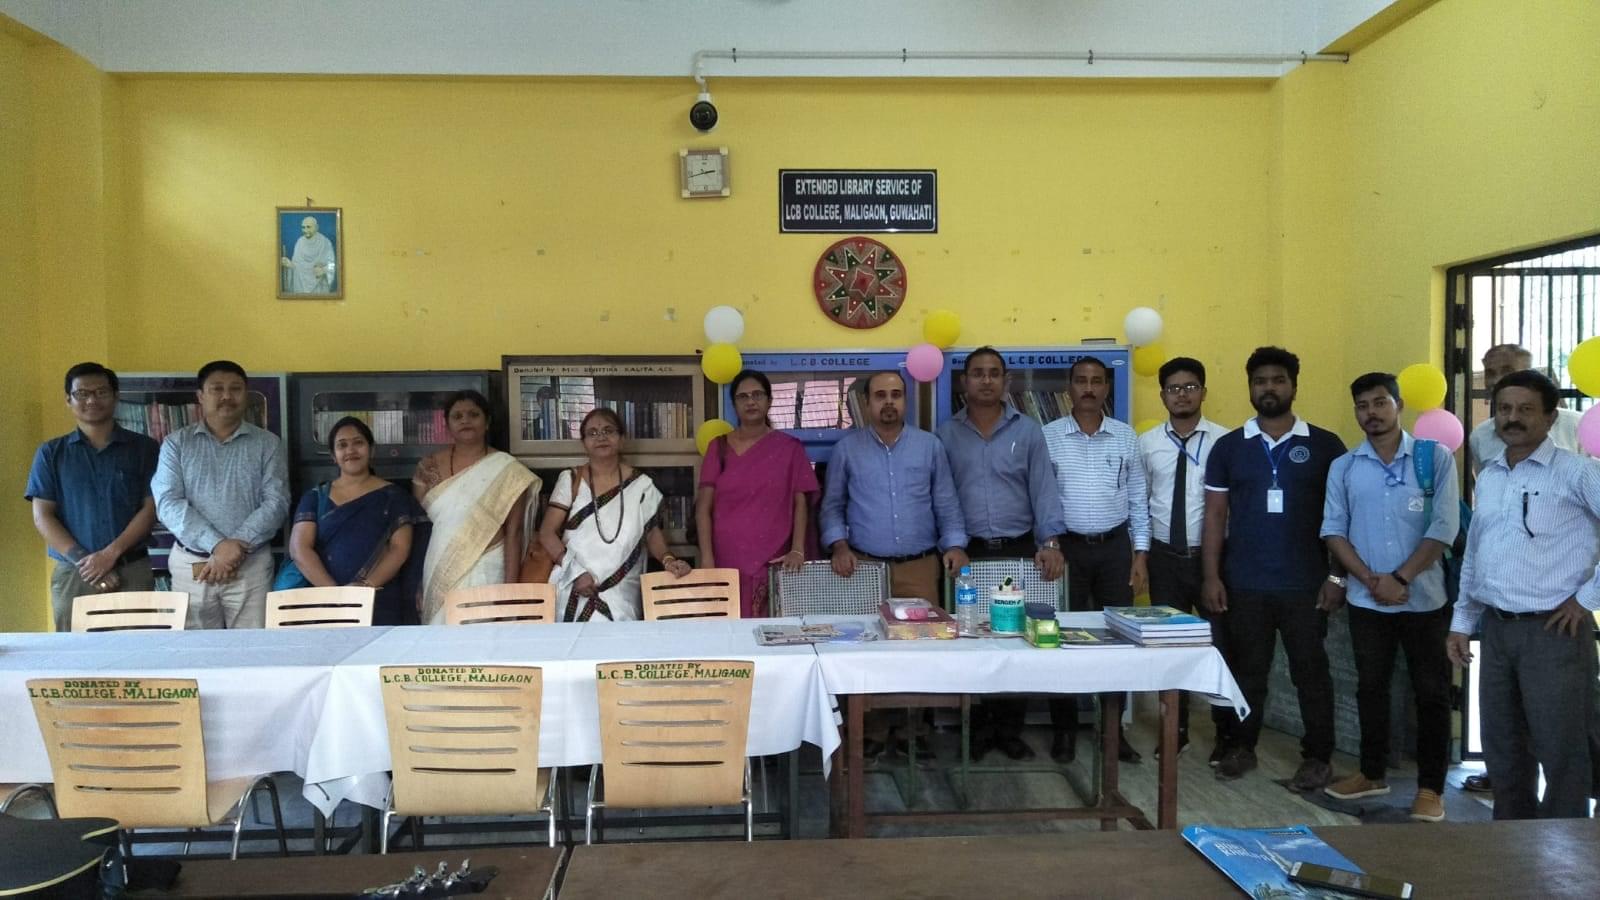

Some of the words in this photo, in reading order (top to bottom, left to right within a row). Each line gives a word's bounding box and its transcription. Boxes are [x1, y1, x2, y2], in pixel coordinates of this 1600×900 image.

[795, 179, 838, 195] EXTENDED
[840, 179, 873, 195] LIBRARY
[875, 179, 909, 195] SERVICE
[911, 179, 923, 195] OF
[785, 204, 801, 220] LCB
[803, 204, 843, 224] COLLEGE,
[844, 204, 888, 225] MALIGAON,
[889, 204, 932, 220] GUWAHATI
[820, 357, 871, 366] COLLEGE
[468, 674, 533, 684] MALIGAON
[694, 669, 751, 679] MALIGAON
[64, 680, 120, 688] DONATED
[124, 680, 141, 688] BY
[123, 687, 199, 699] MALIGAON
